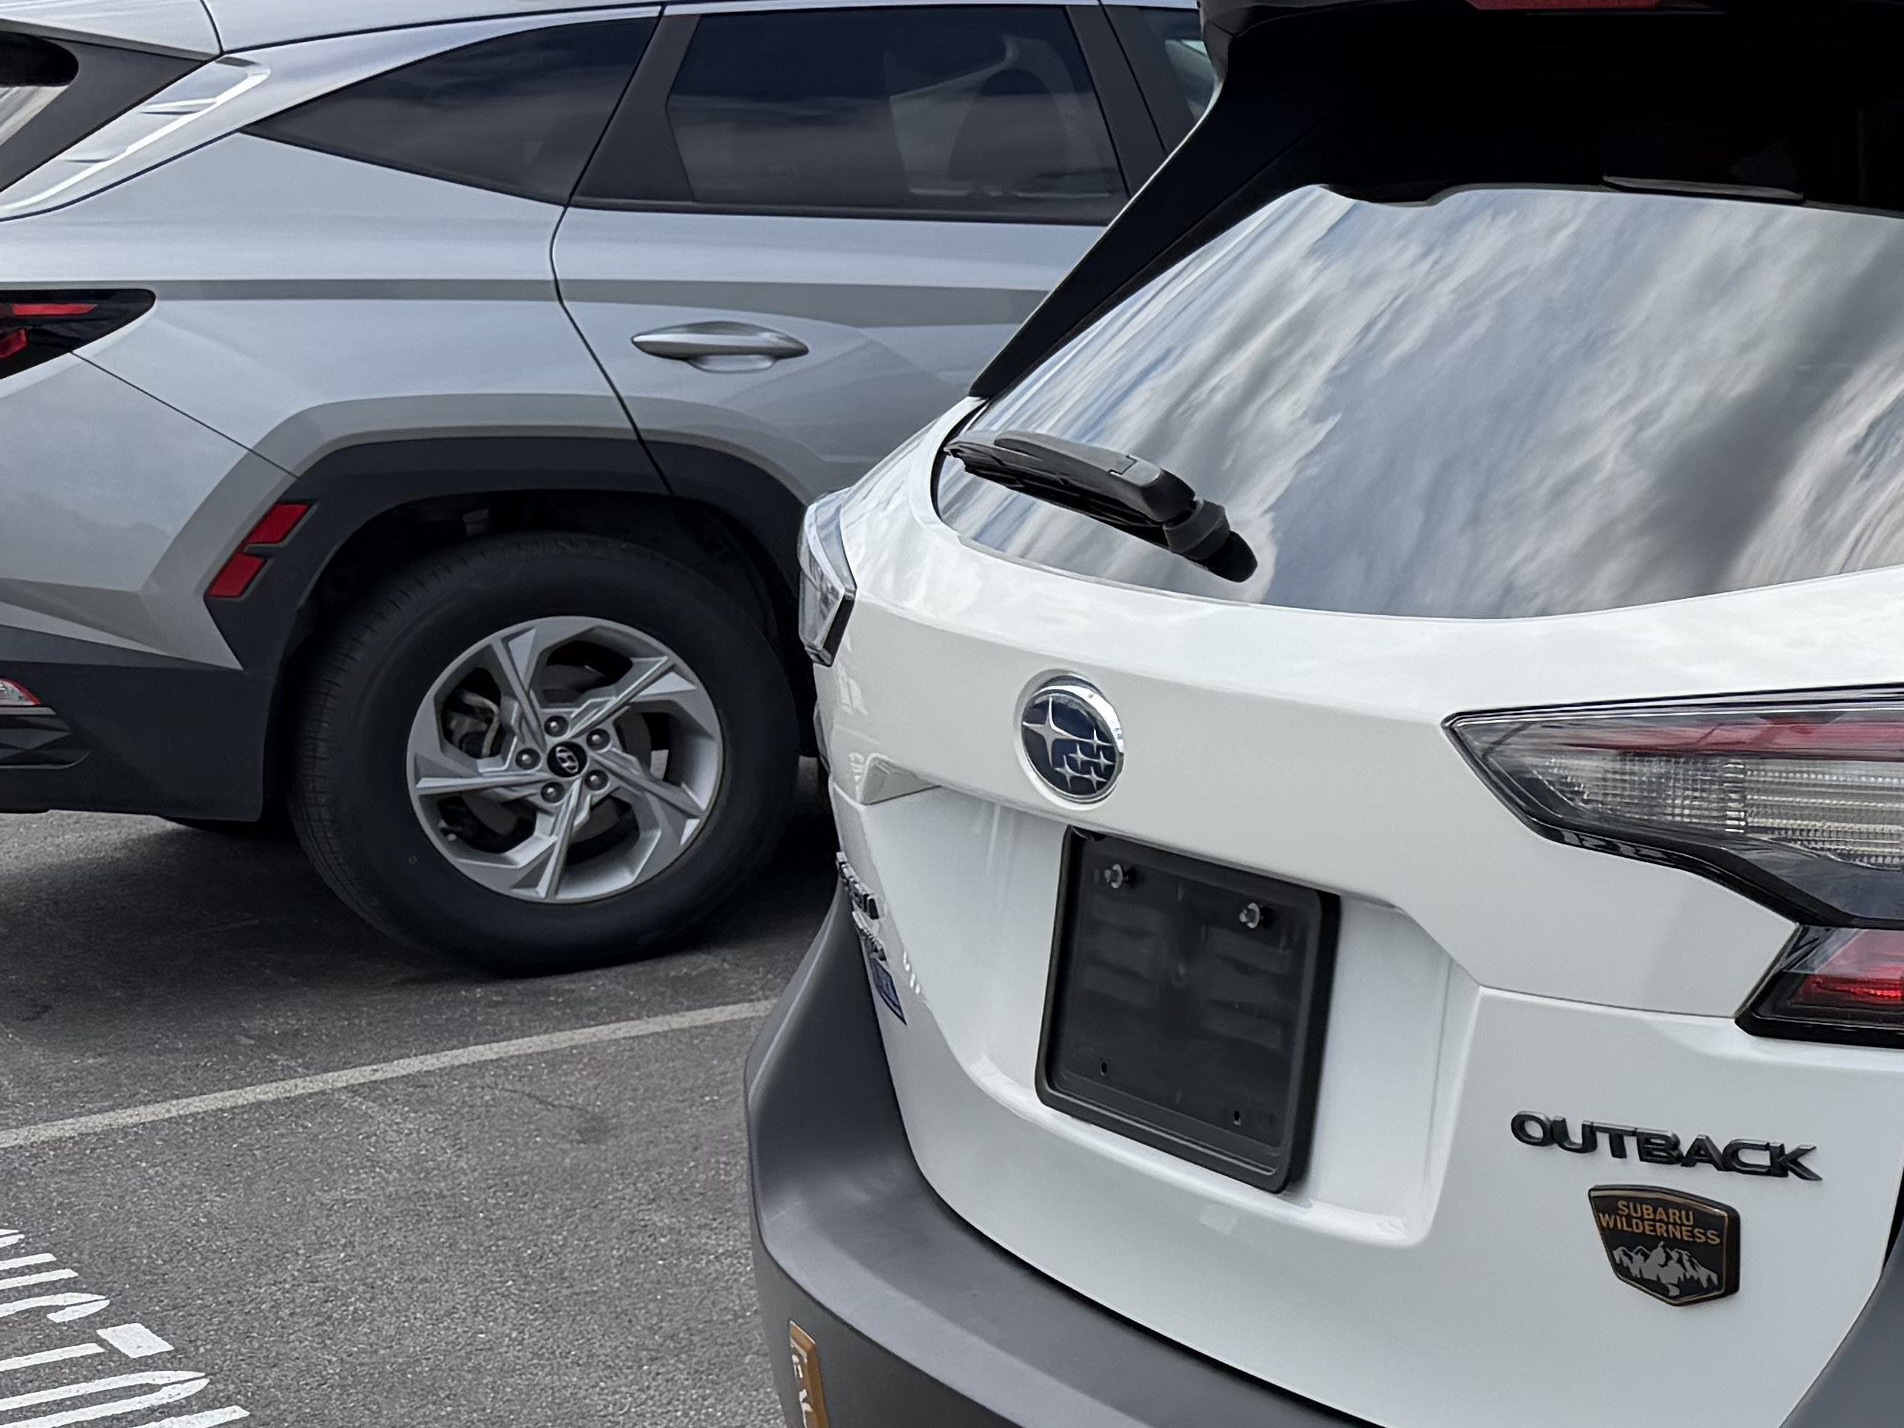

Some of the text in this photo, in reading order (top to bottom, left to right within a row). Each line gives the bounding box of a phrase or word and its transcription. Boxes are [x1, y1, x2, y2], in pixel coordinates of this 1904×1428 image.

[1510, 1110, 1823, 1182] OUTBACK
[1600, 1212, 1721, 1246] WILDERNESS
[1617, 1200, 1694, 1226] SUBARU
